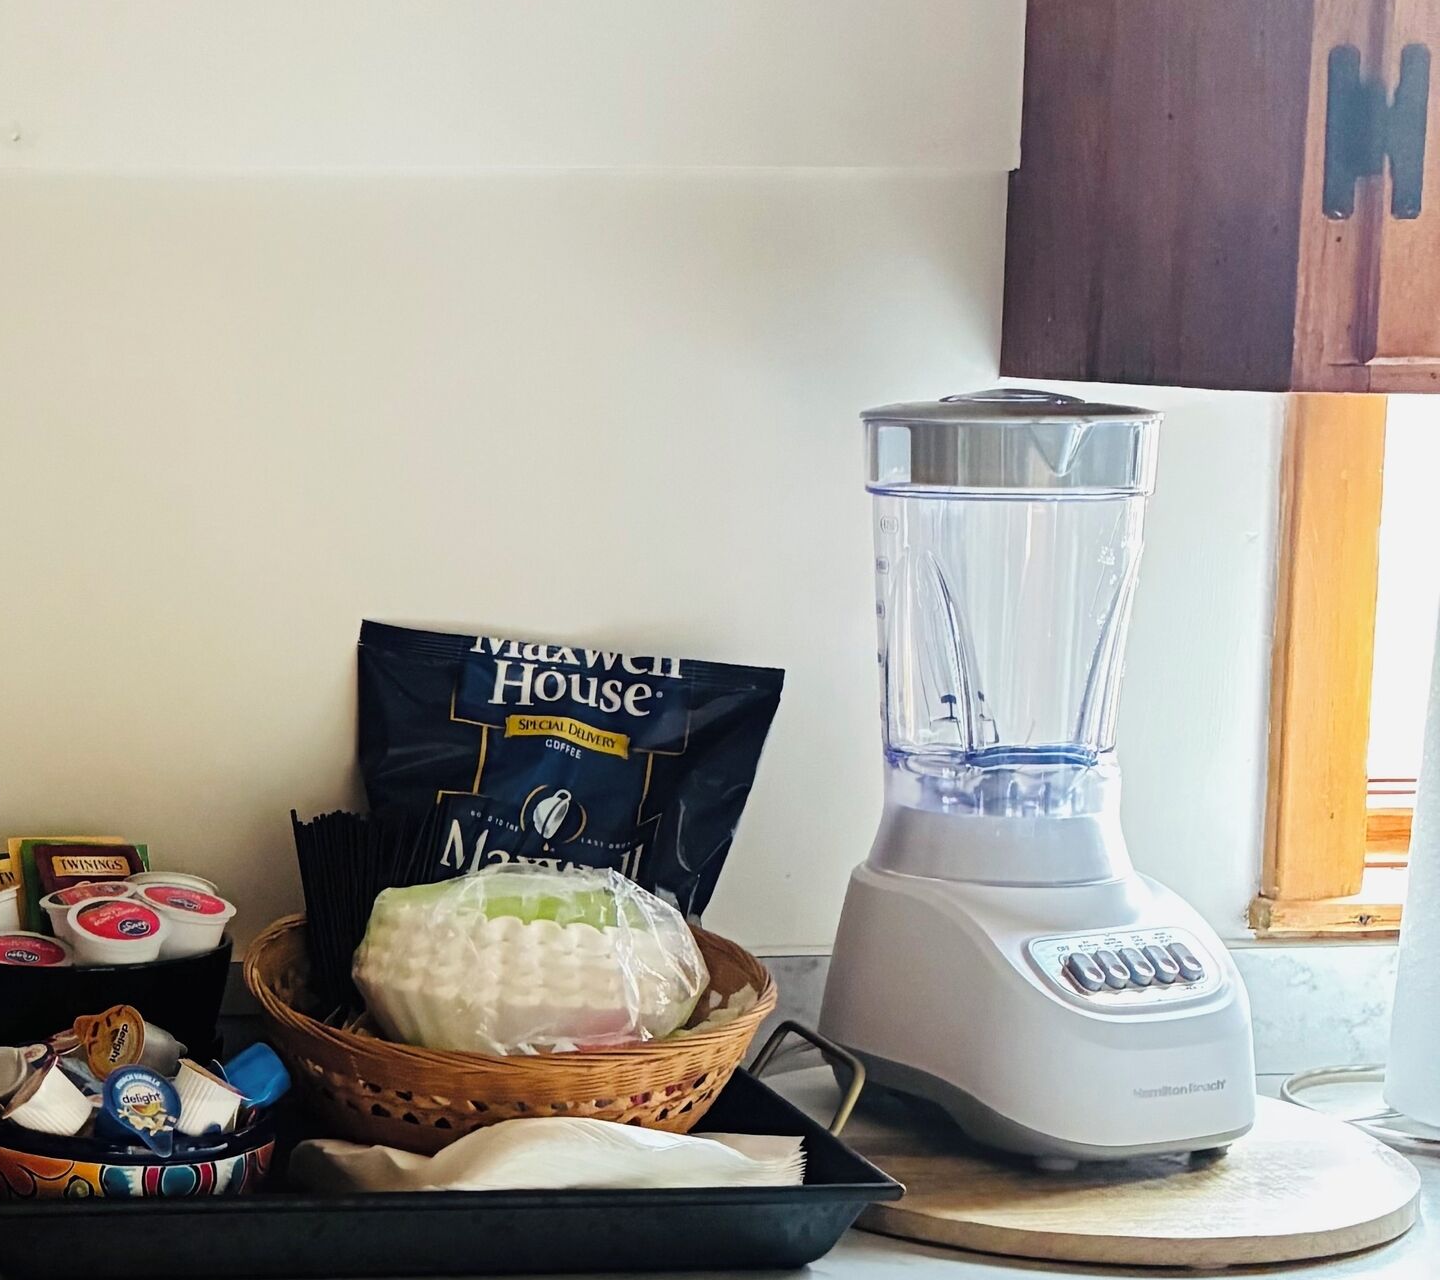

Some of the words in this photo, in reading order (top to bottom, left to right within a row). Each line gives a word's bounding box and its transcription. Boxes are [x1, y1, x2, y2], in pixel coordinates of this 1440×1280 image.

[487, 658, 653, 717] House
[518, 718, 566, 732] SPECIAL
[568, 722, 617, 749] DELIVERY
[545, 738, 582, 760] COFFEE
[61, 858, 123, 871] TWININGS
[109, 1023, 129, 1063] delight
[122, 1092, 161, 1104] delight
